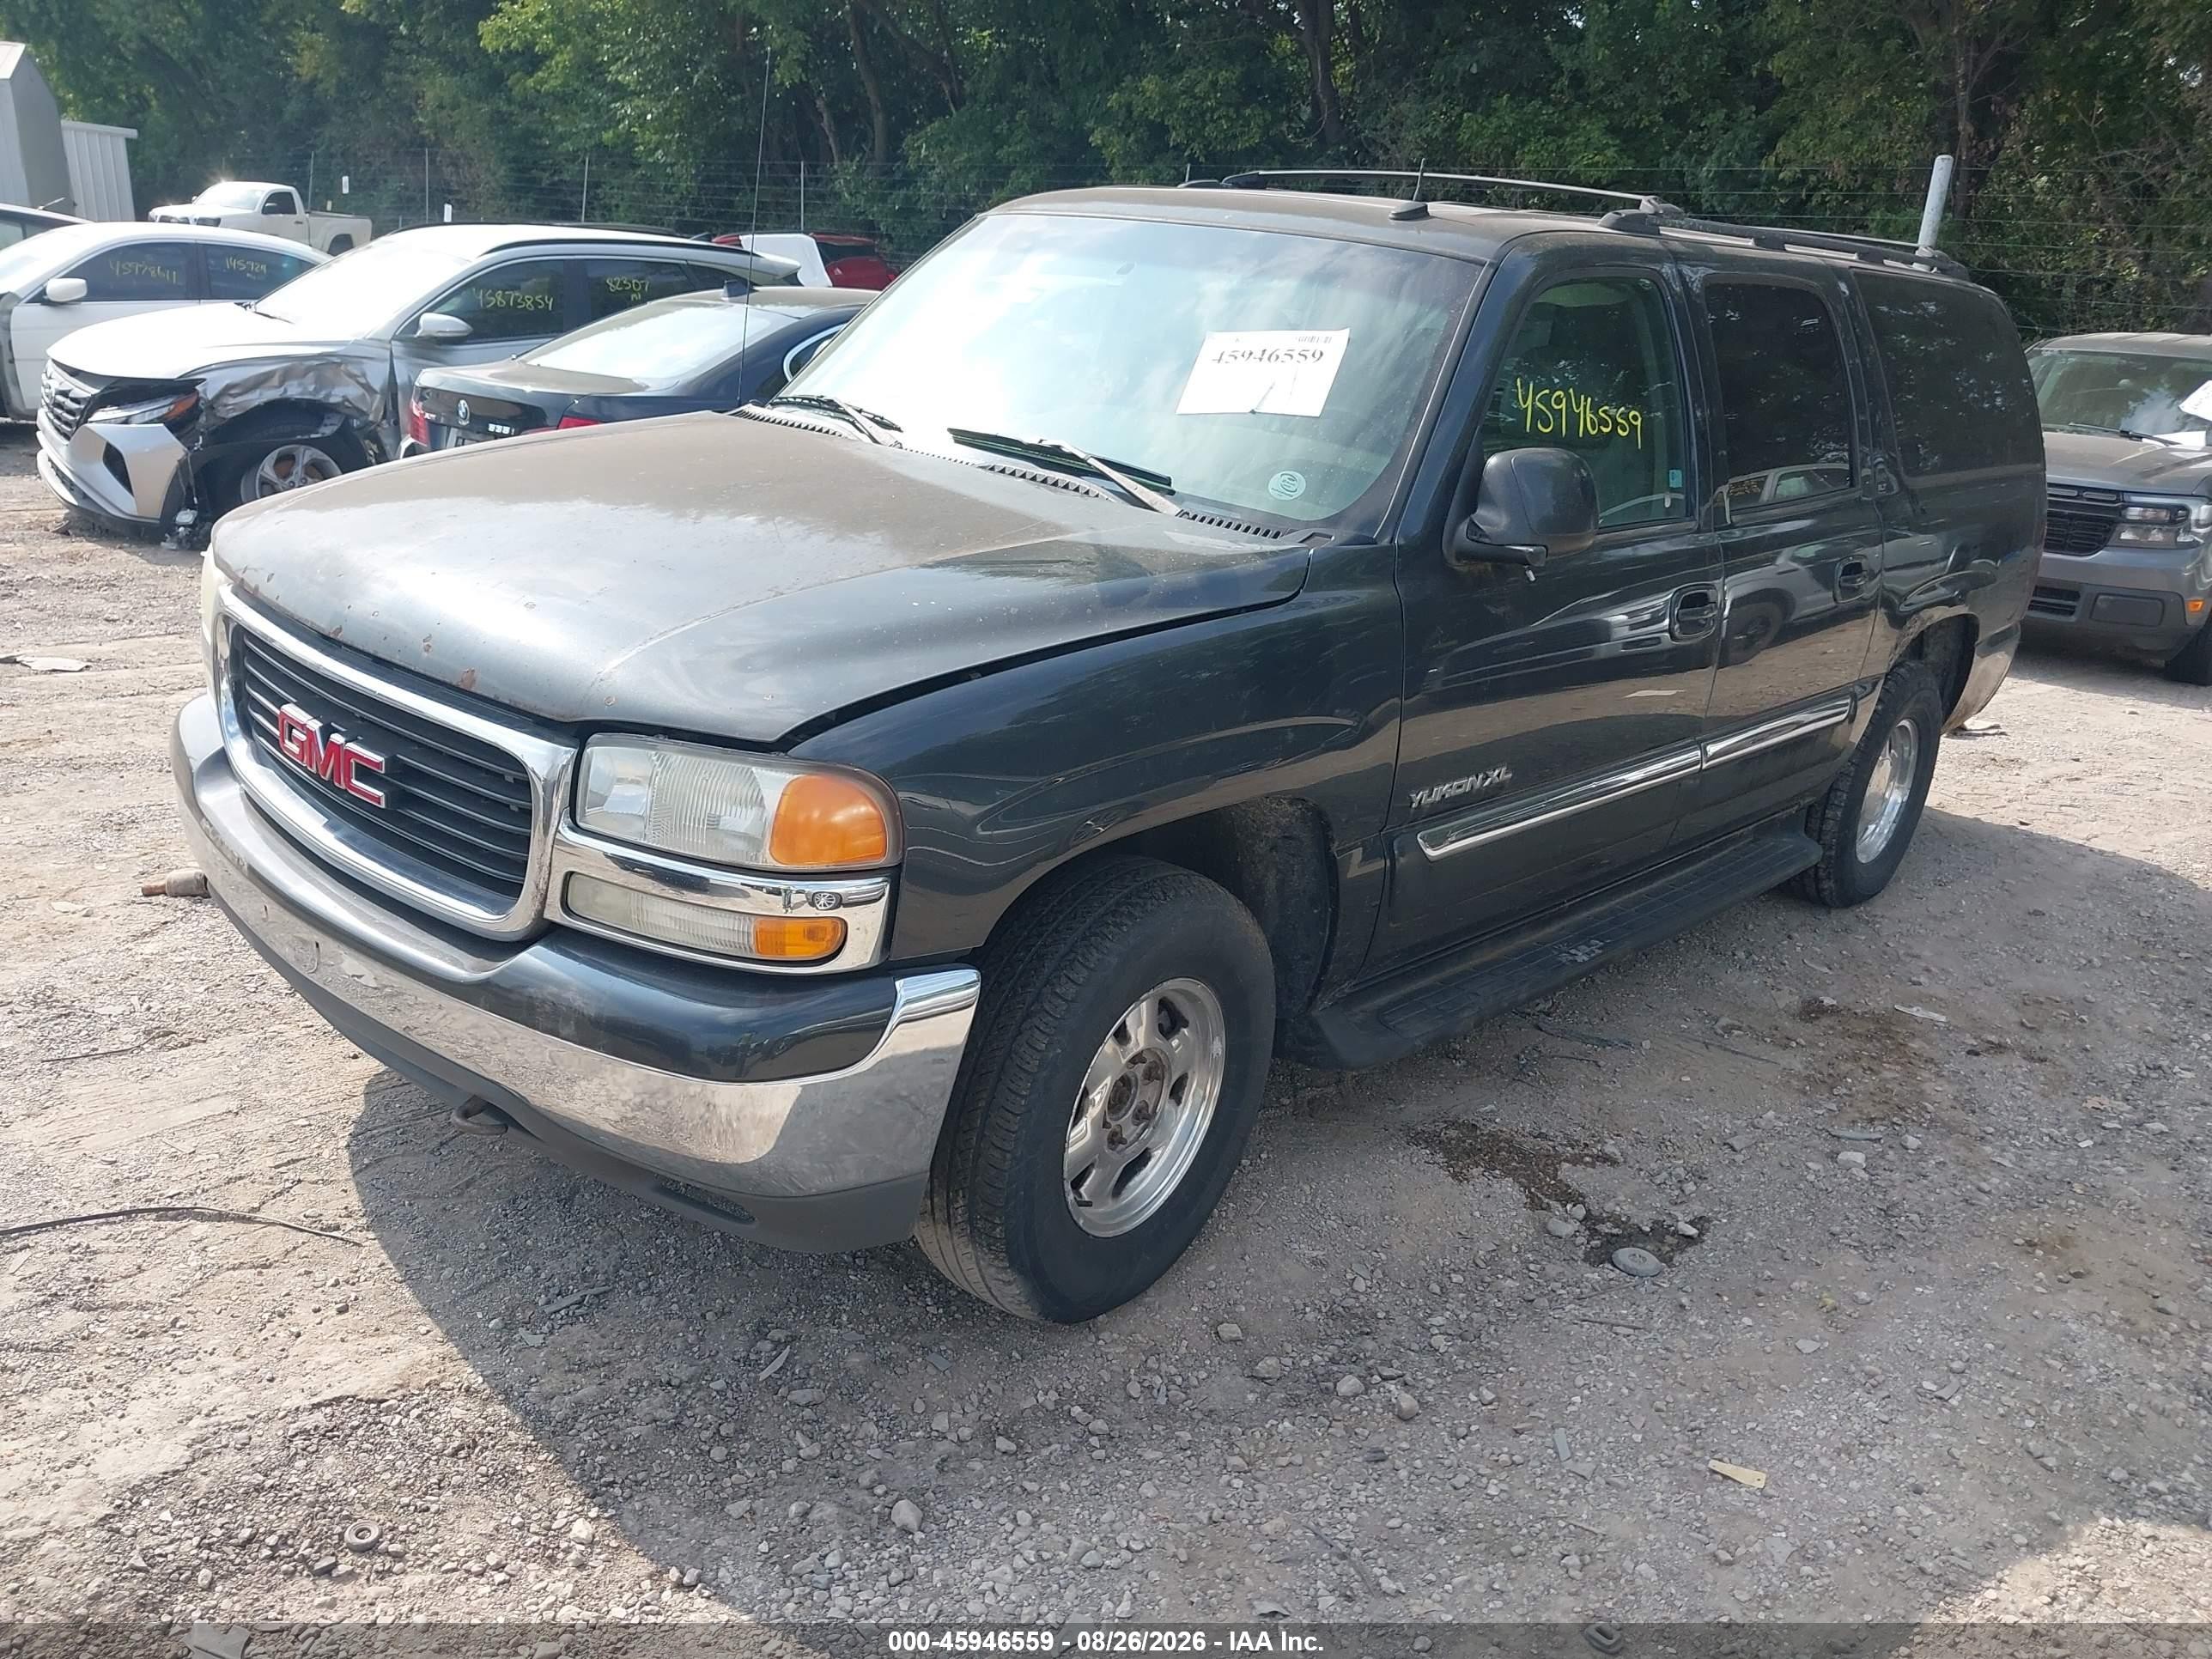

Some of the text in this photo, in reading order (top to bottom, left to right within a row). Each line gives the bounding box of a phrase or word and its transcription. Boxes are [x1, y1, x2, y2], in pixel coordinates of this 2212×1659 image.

[473, 287, 554, 311] 45873854
[1211, 349, 1324, 364] 45946559
[1516, 377, 1642, 450] 45946559
[278, 702, 386, 808] GMC
[1408, 766, 1513, 809] YUKON XL
